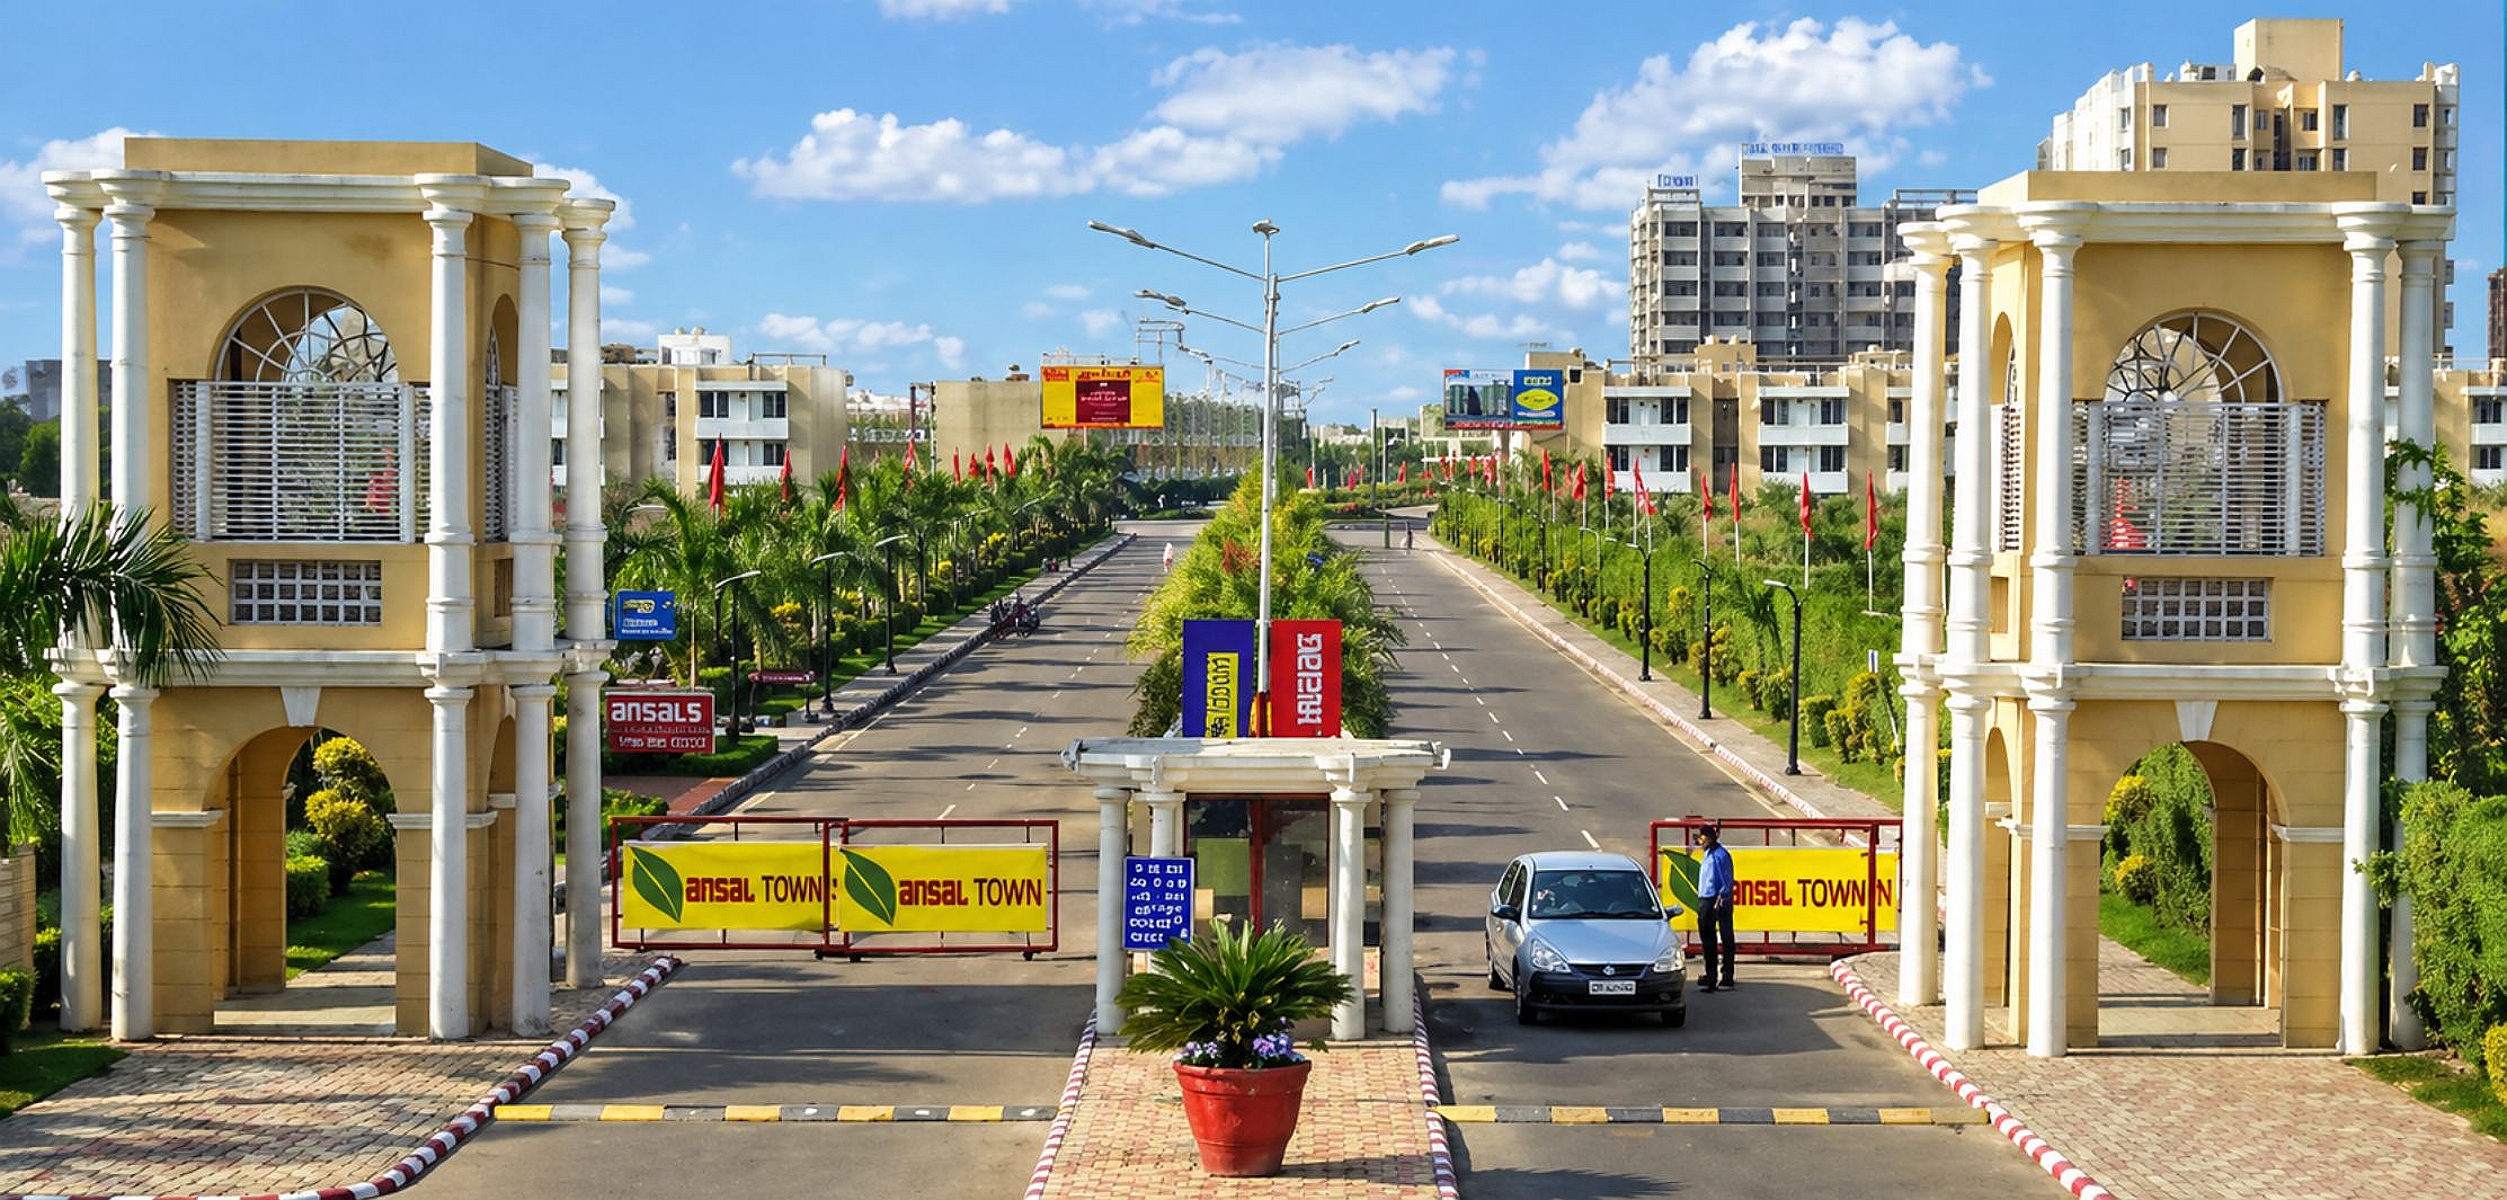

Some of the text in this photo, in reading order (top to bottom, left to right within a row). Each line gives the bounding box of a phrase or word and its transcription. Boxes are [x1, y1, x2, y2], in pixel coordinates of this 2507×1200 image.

[761, 875, 822, 903] TOWN
[973, 877, 1041, 907] TOWN
[1797, 878, 1866, 907] TOWN
